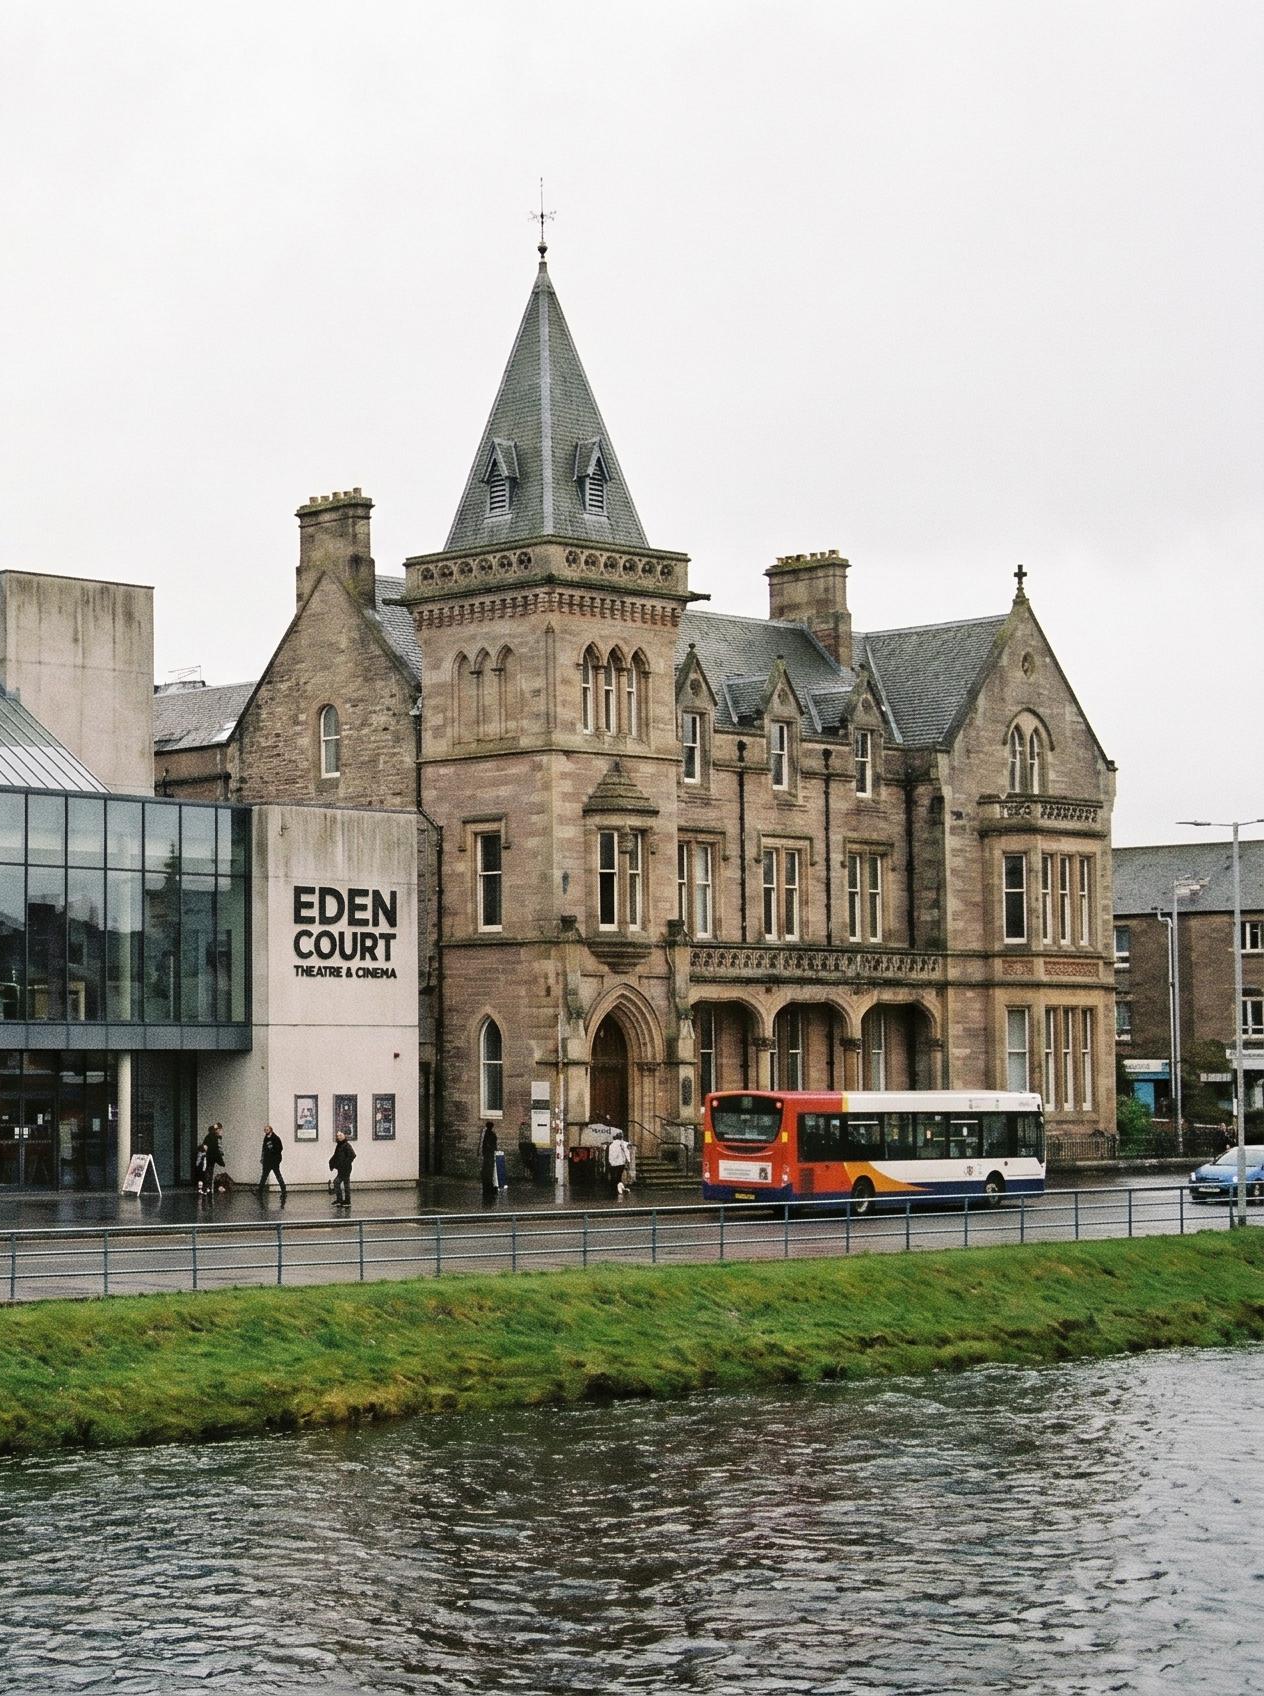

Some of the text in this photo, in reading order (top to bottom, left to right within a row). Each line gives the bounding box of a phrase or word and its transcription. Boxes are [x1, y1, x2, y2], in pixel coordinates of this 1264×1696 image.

[294, 886, 397, 928] EDEN
[294, 929, 396, 962] COURT
[293, 965, 397, 979] THEATRE & CINEMA
